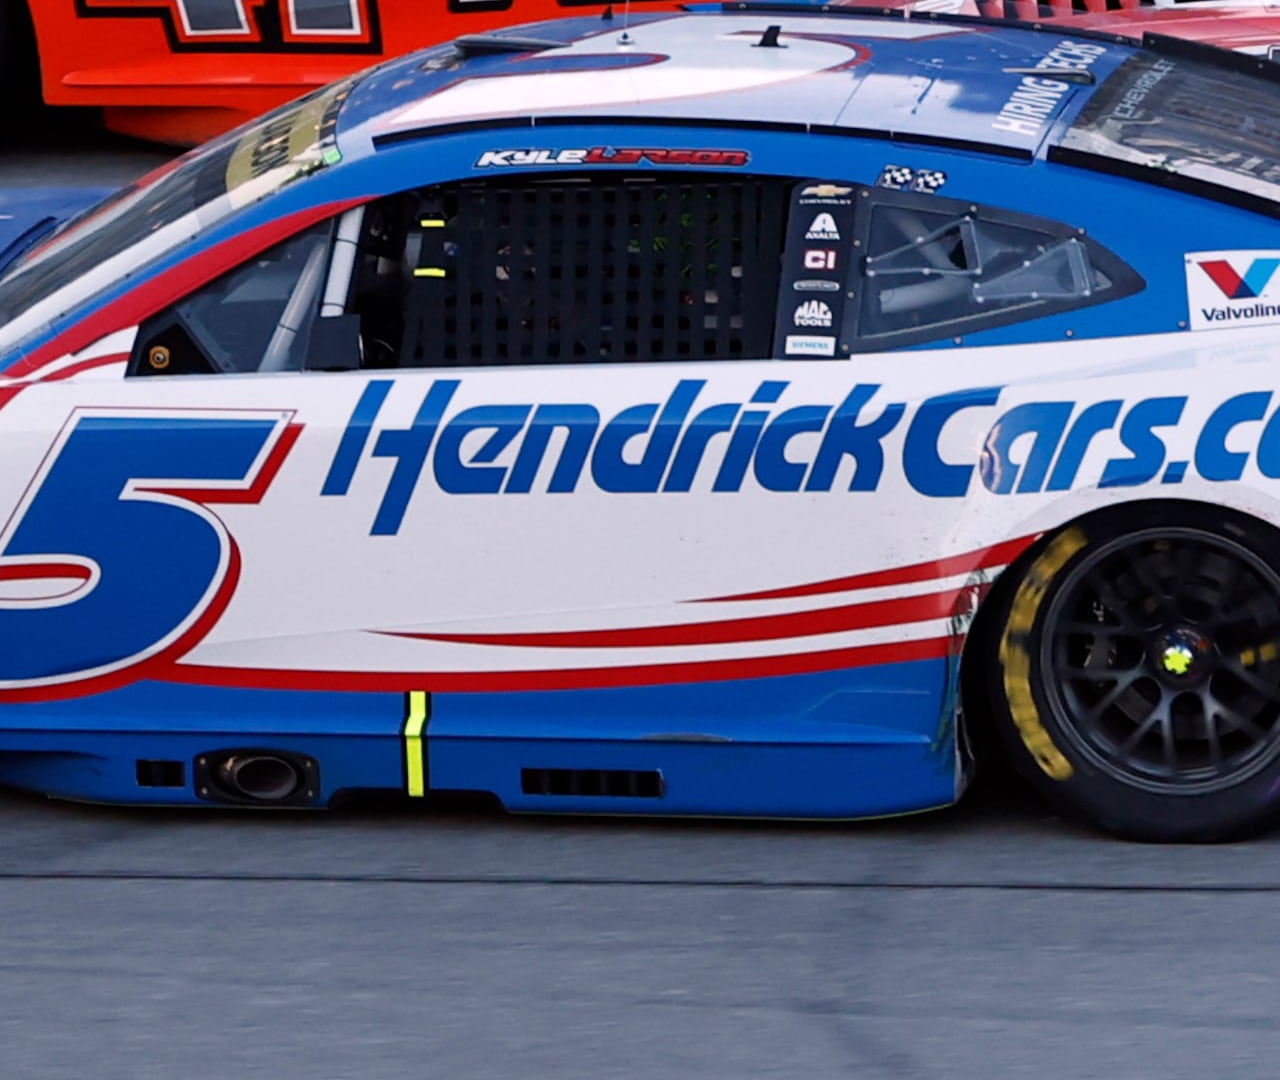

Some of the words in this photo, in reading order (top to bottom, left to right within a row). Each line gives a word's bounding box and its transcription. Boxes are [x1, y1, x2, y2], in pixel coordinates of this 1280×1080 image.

[991, 76, 1069, 136] HIRING
[476, 149, 587, 167] KYLE
[584, 148, 748, 166] LARSON
